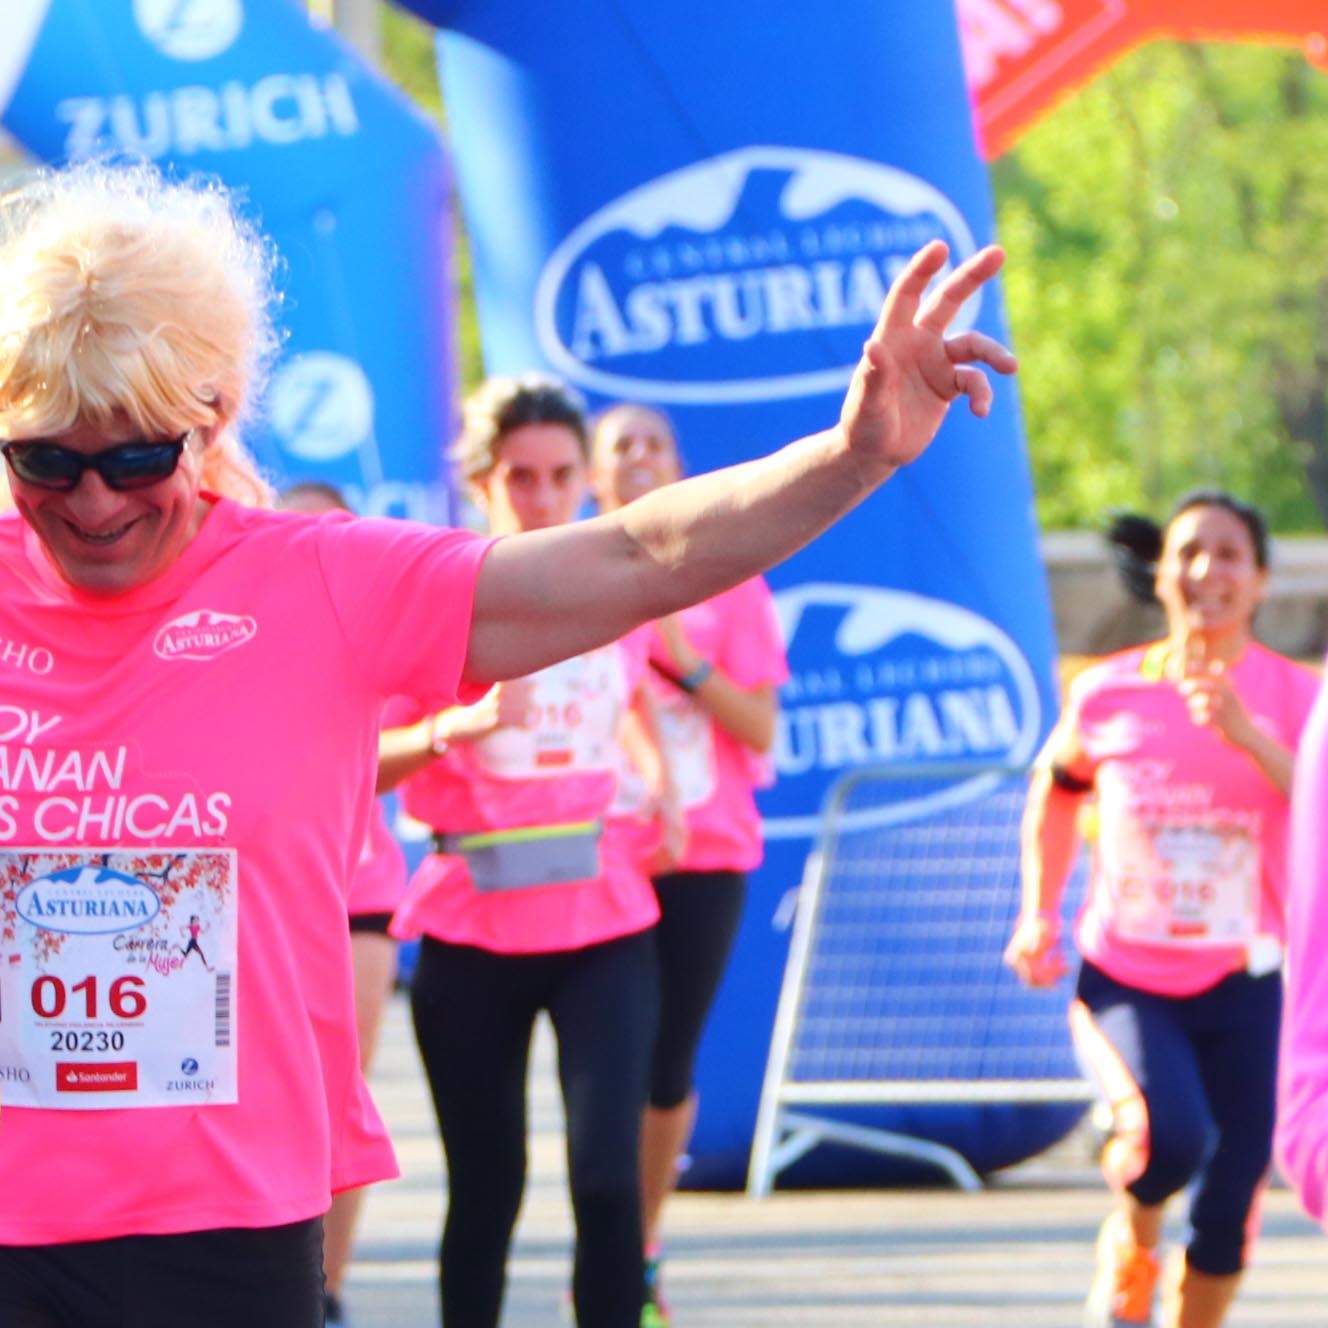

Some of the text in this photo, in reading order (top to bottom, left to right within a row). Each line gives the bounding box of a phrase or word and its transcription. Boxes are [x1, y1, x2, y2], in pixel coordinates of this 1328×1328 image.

[56, 72, 358, 160] ZURICH
[574, 254, 918, 362] ASTURIA
[161, 623, 249, 654] ASTURIANA
[775, 684, 1020, 776] URIANA
[33, 791, 232, 841] CHICAS
[27, 890, 149, 917] ASTURIANA
[145, 950, 186, 977] Mujer
[30, 974, 147, 1019] 016
[50, 1030, 125, 1052] 20230
[78, 1070, 128, 1084] Santander
[166, 1079, 216, 1092] ZURICH
